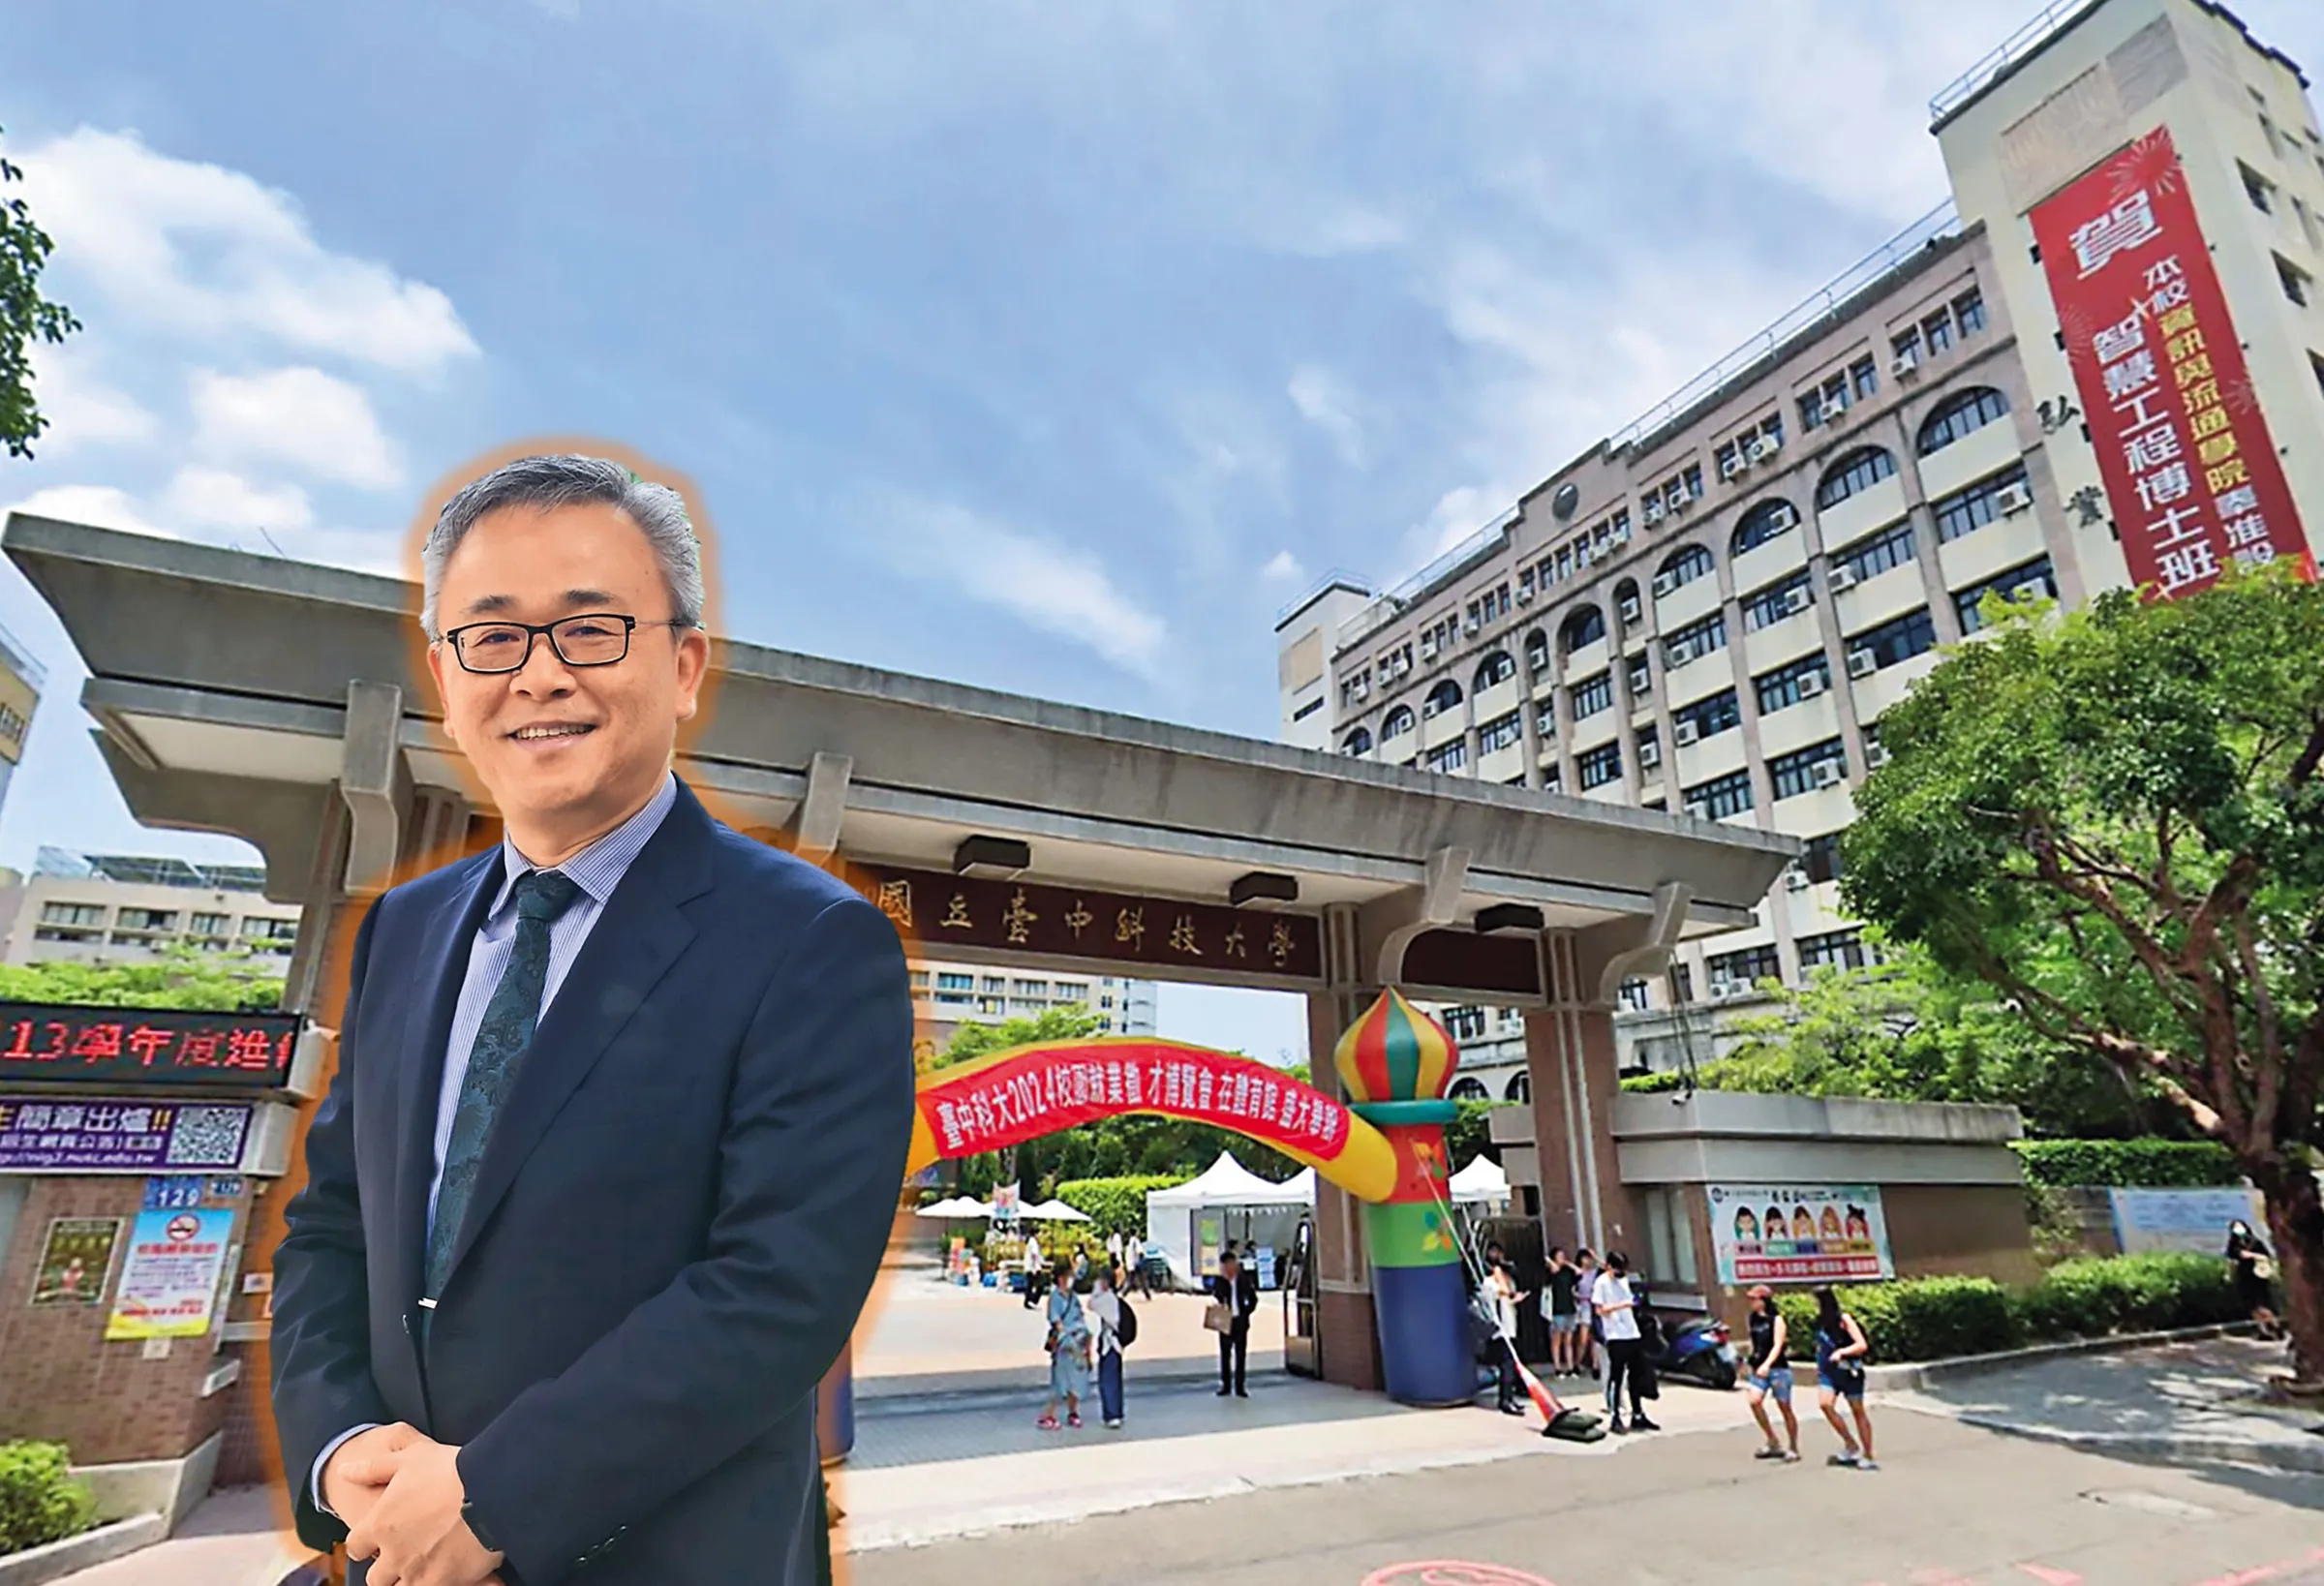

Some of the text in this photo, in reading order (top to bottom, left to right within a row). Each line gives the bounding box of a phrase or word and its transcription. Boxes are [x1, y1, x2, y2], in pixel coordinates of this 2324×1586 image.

[2068, 189, 2163, 280] 賀
[2093, 315, 2221, 593] 智慧工程博士班
[159, 1187, 199, 1207] 129
